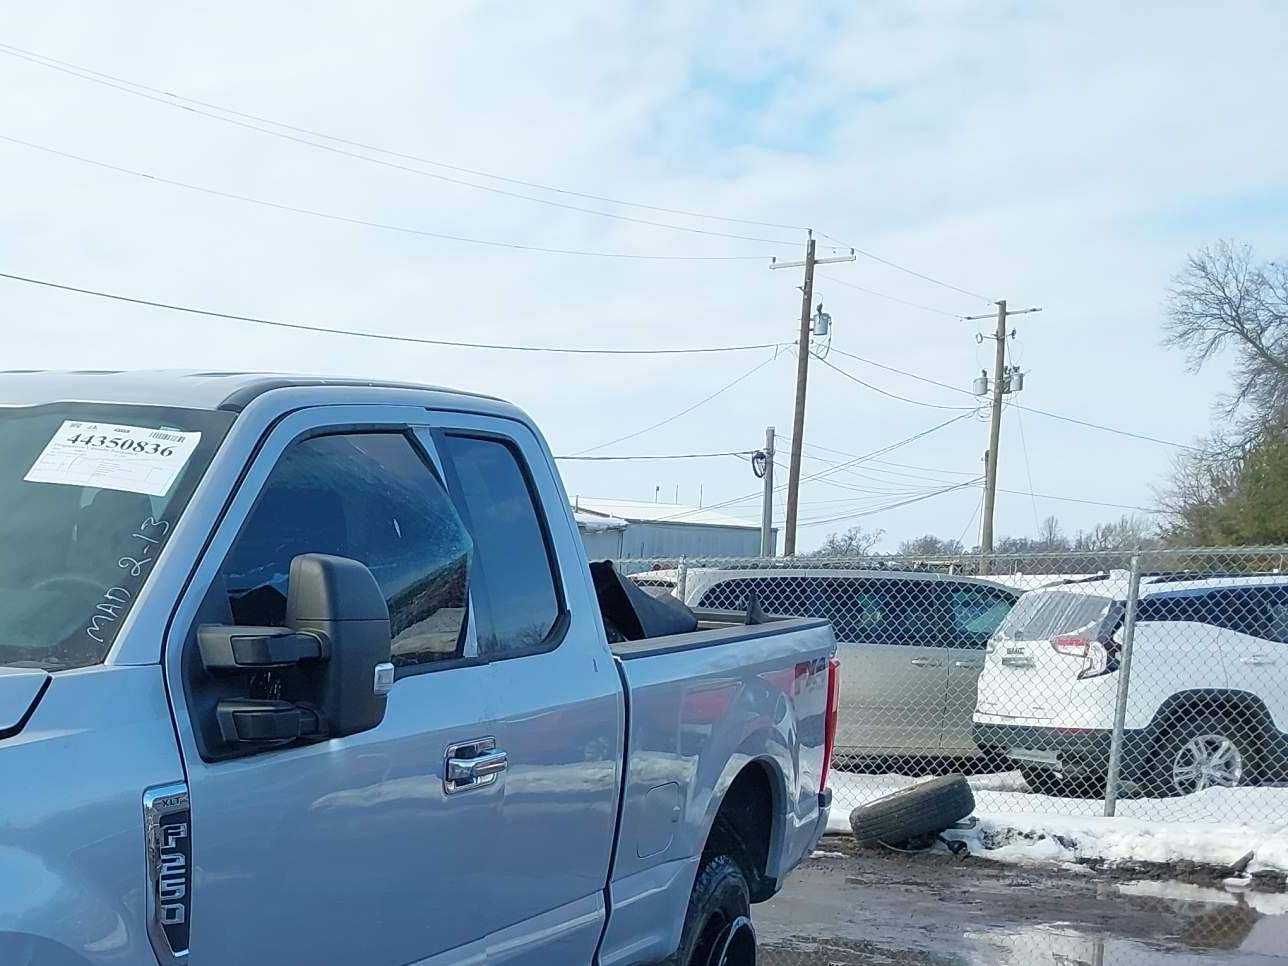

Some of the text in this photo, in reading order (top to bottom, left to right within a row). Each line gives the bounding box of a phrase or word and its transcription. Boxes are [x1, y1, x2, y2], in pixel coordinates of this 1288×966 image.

[66, 433, 176, 457] 44350836
[118, 516, 170, 577] 2-13
[794, 656, 826, 697] FX4
[162, 797, 181, 807] XLT
